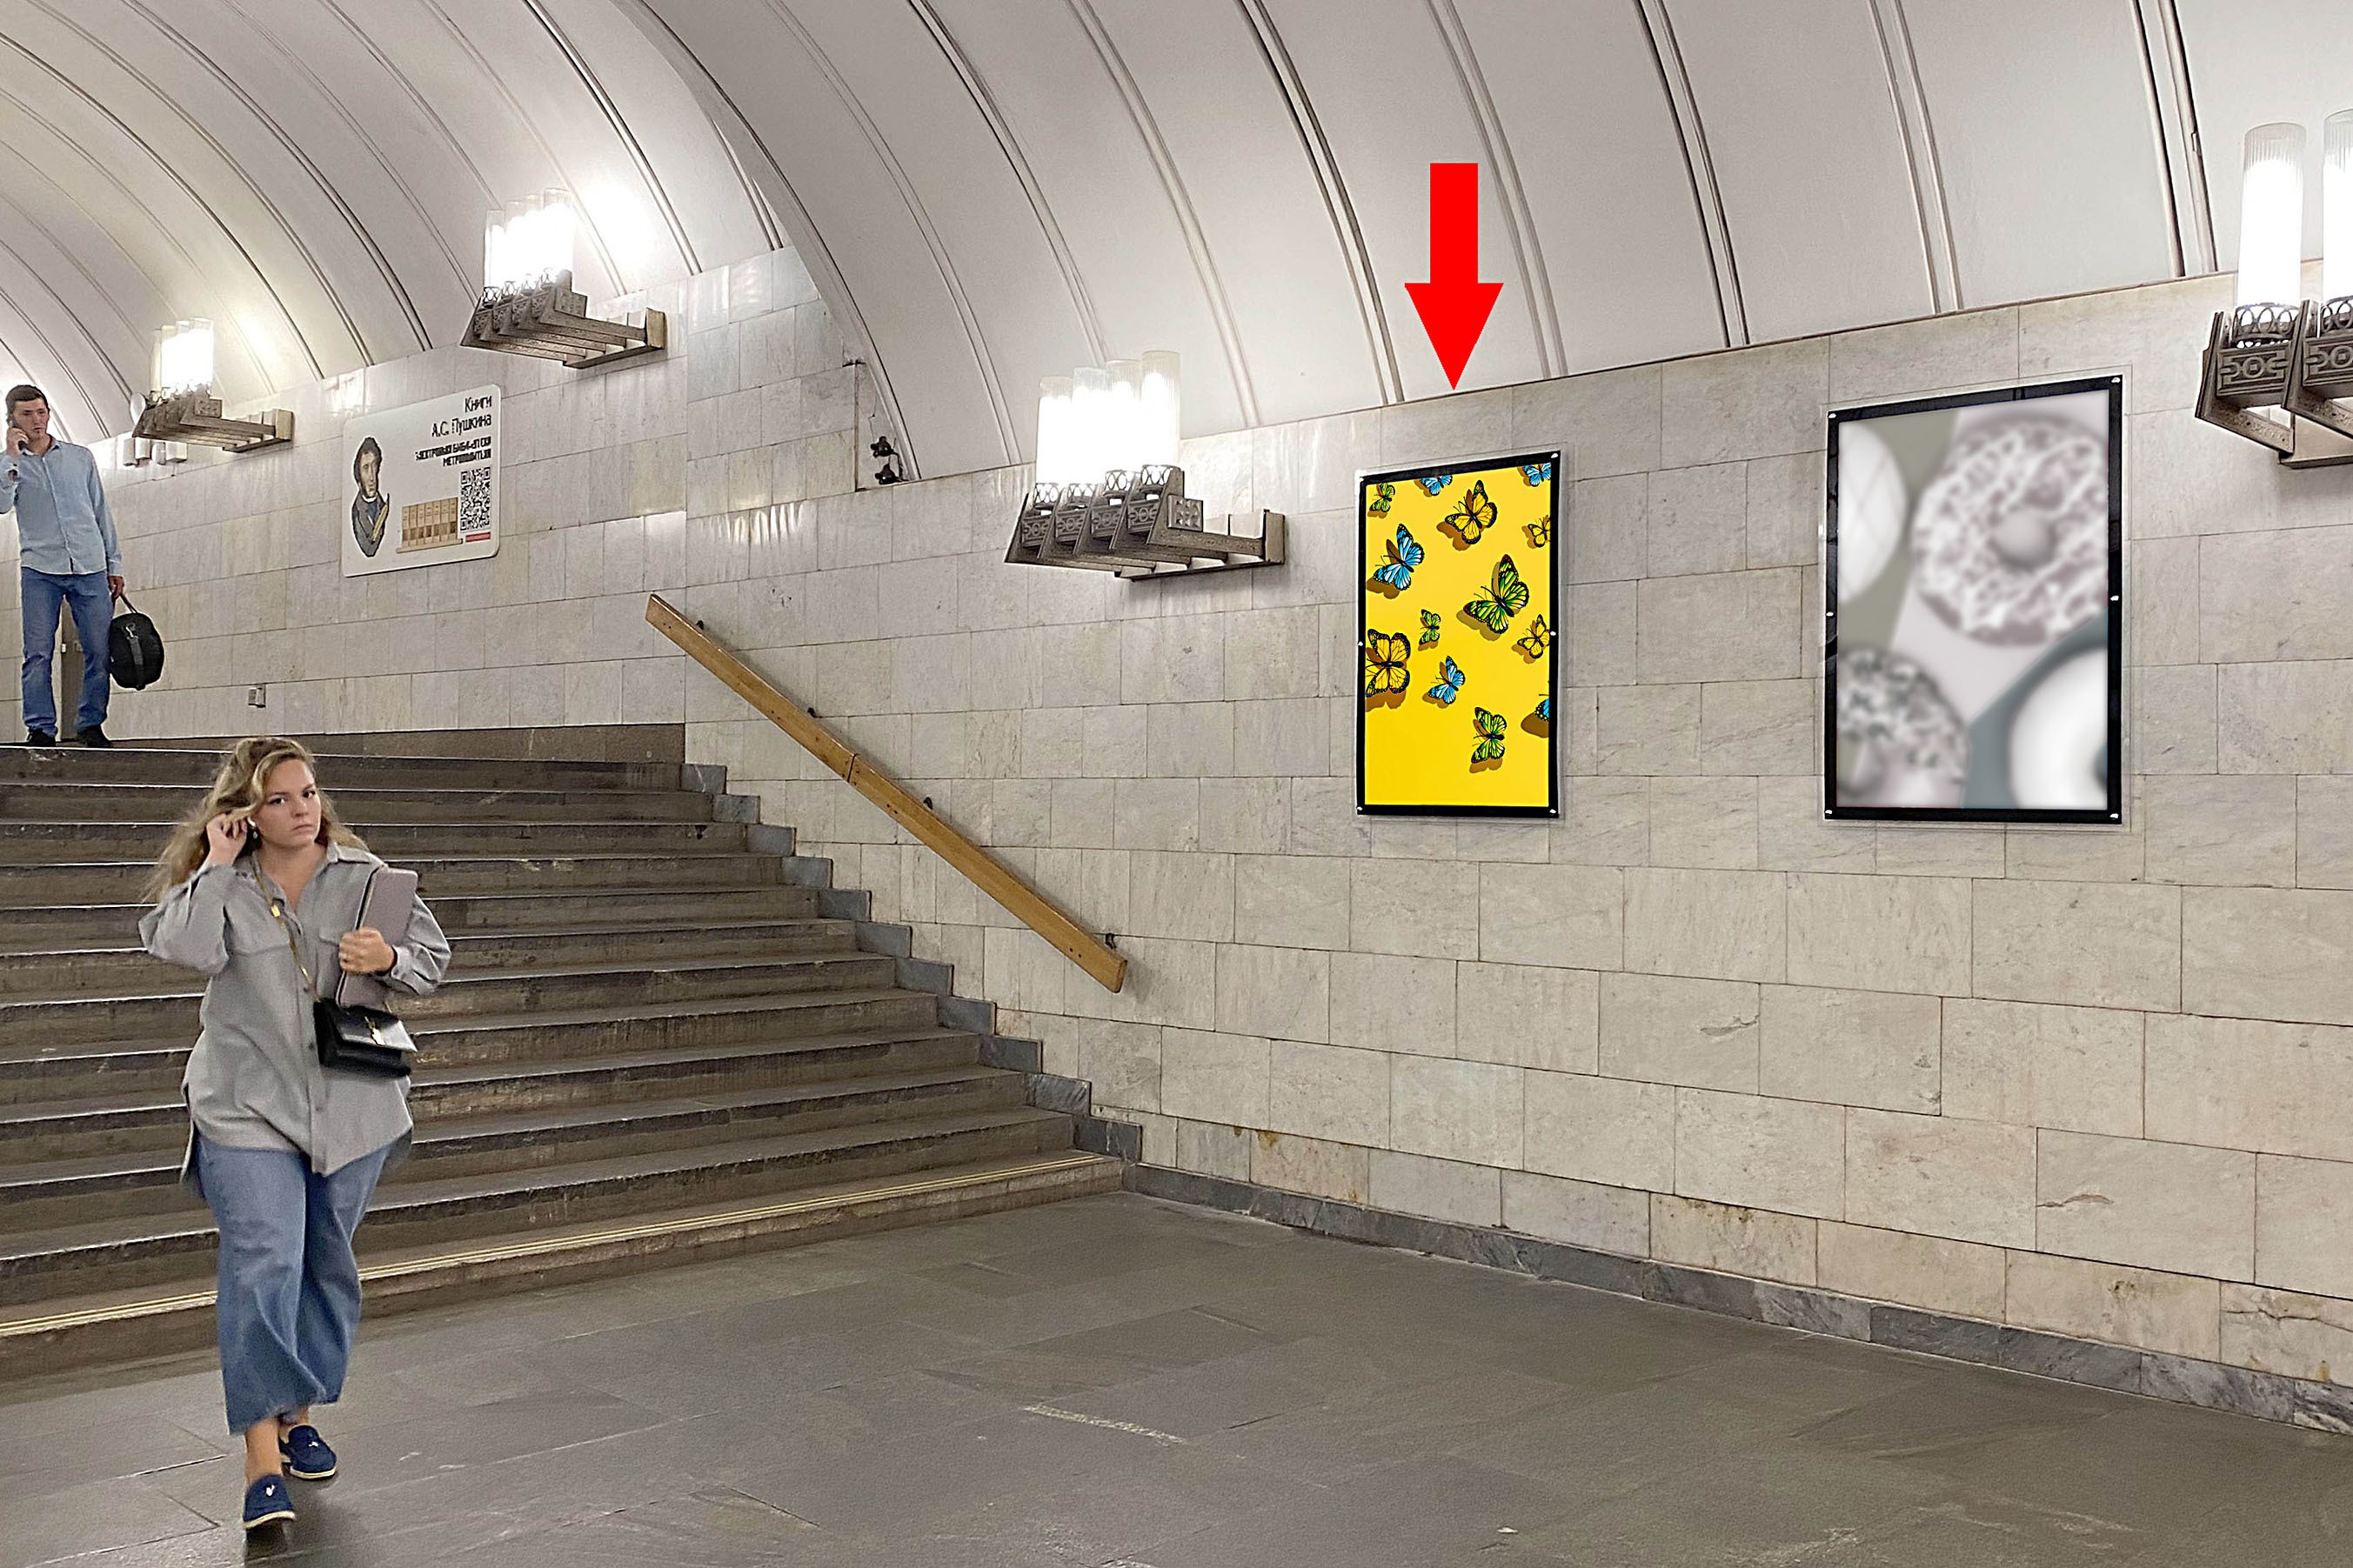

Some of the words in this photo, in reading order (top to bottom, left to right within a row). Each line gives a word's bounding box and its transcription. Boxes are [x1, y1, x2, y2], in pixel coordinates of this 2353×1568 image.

[465, 396, 492, 413] Книги
[431, 421, 450, 437] А.С.
[451, 414, 492, 436] Пушкина
